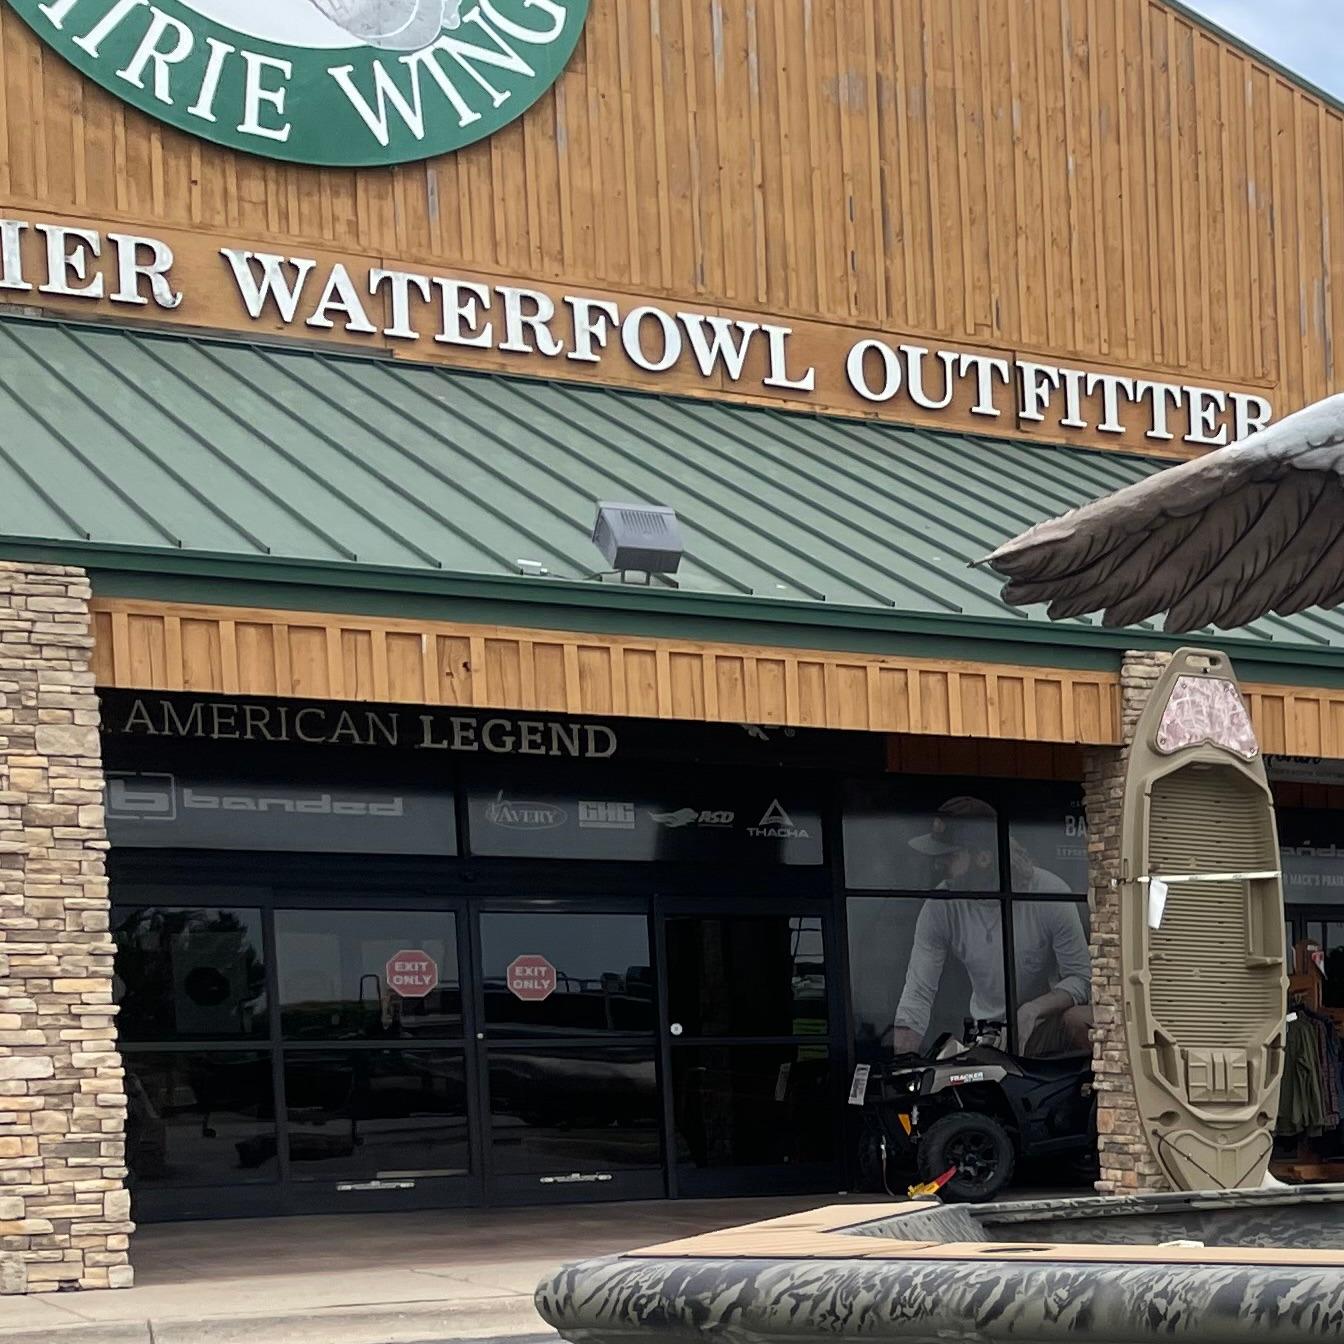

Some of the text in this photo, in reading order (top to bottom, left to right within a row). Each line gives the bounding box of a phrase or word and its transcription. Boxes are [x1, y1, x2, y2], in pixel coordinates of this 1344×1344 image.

[219, 248, 815, 391] WATERFOWL
[121, 699, 617, 758] AMERICAN LEGEND
[183, 788, 404, 817] banded
[496, 806, 555, 825] AVERY
[394, 961, 428, 972] EXIT
[515, 966, 547, 977] EXIT
[393, 974, 432, 986] ONLY
[513, 979, 551, 990] ONLY
